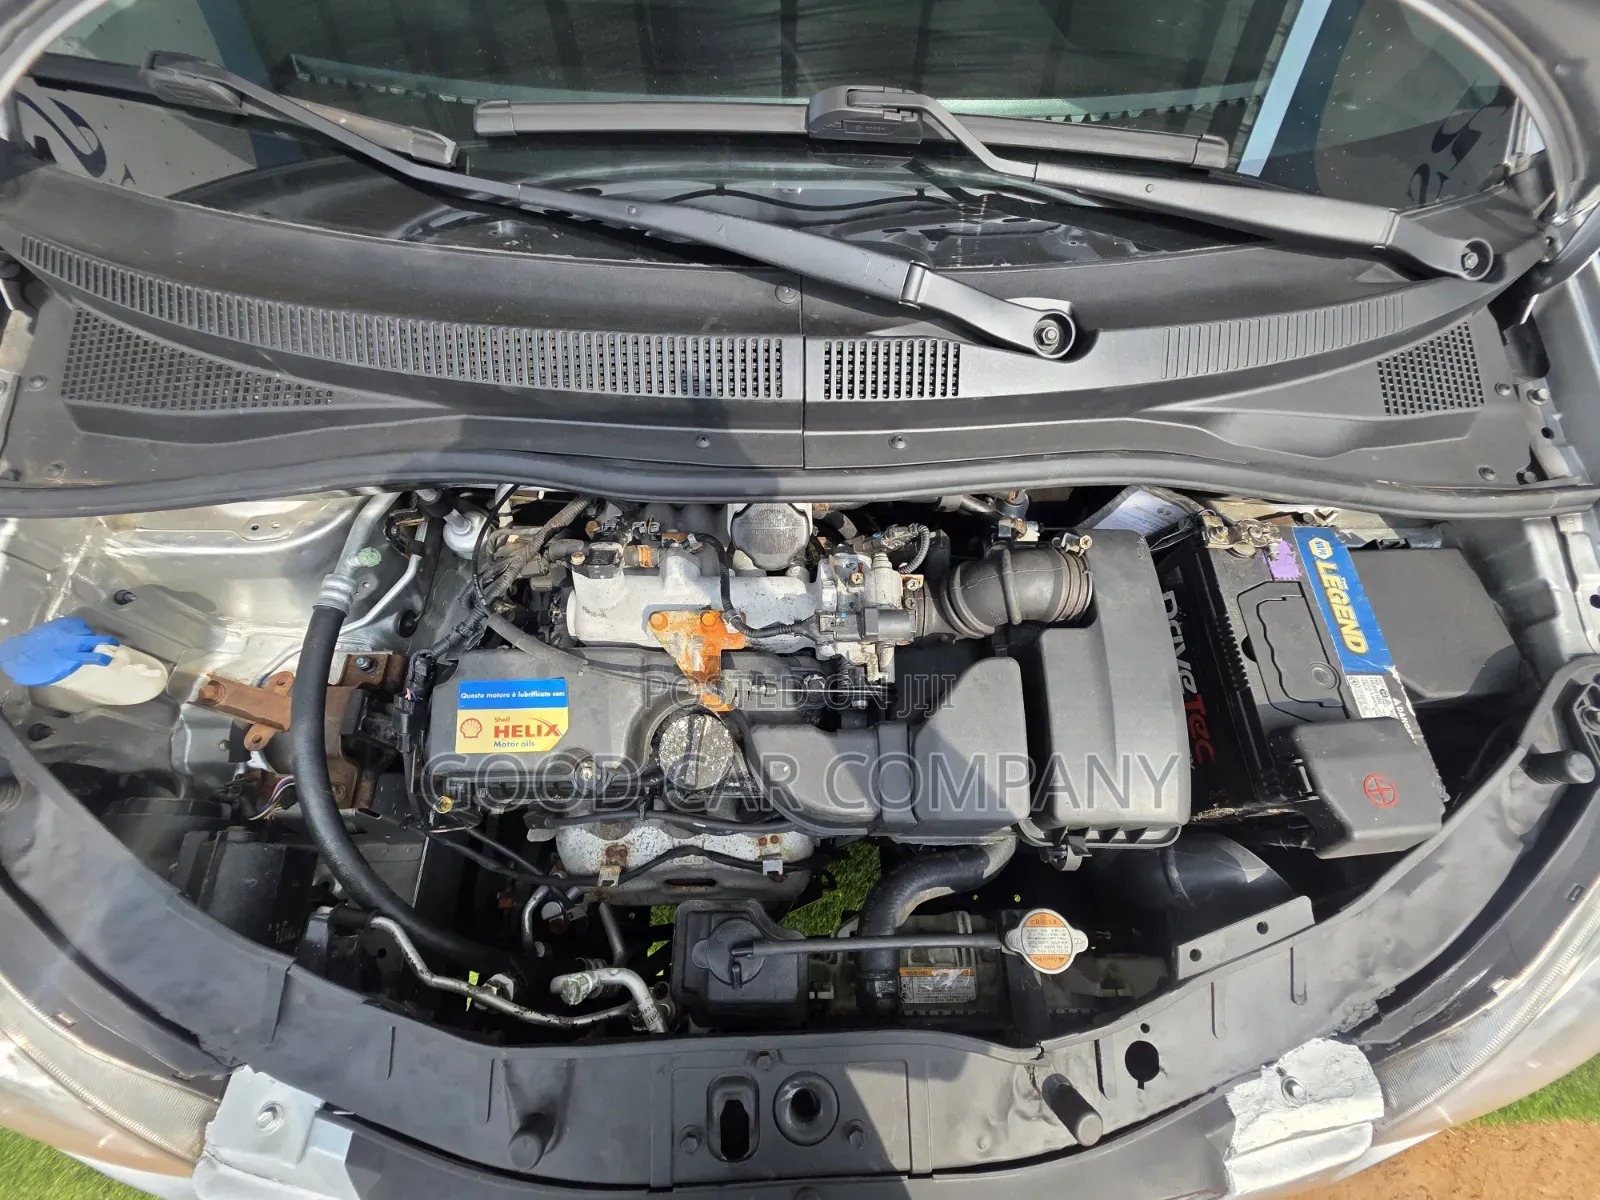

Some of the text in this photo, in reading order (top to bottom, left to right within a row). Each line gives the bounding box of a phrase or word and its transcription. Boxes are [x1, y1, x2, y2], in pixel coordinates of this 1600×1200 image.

[1315, 560, 1369, 654] LEGEND
[517, 690, 551, 698] lubrificato
[494, 724, 561, 738] HELIX
